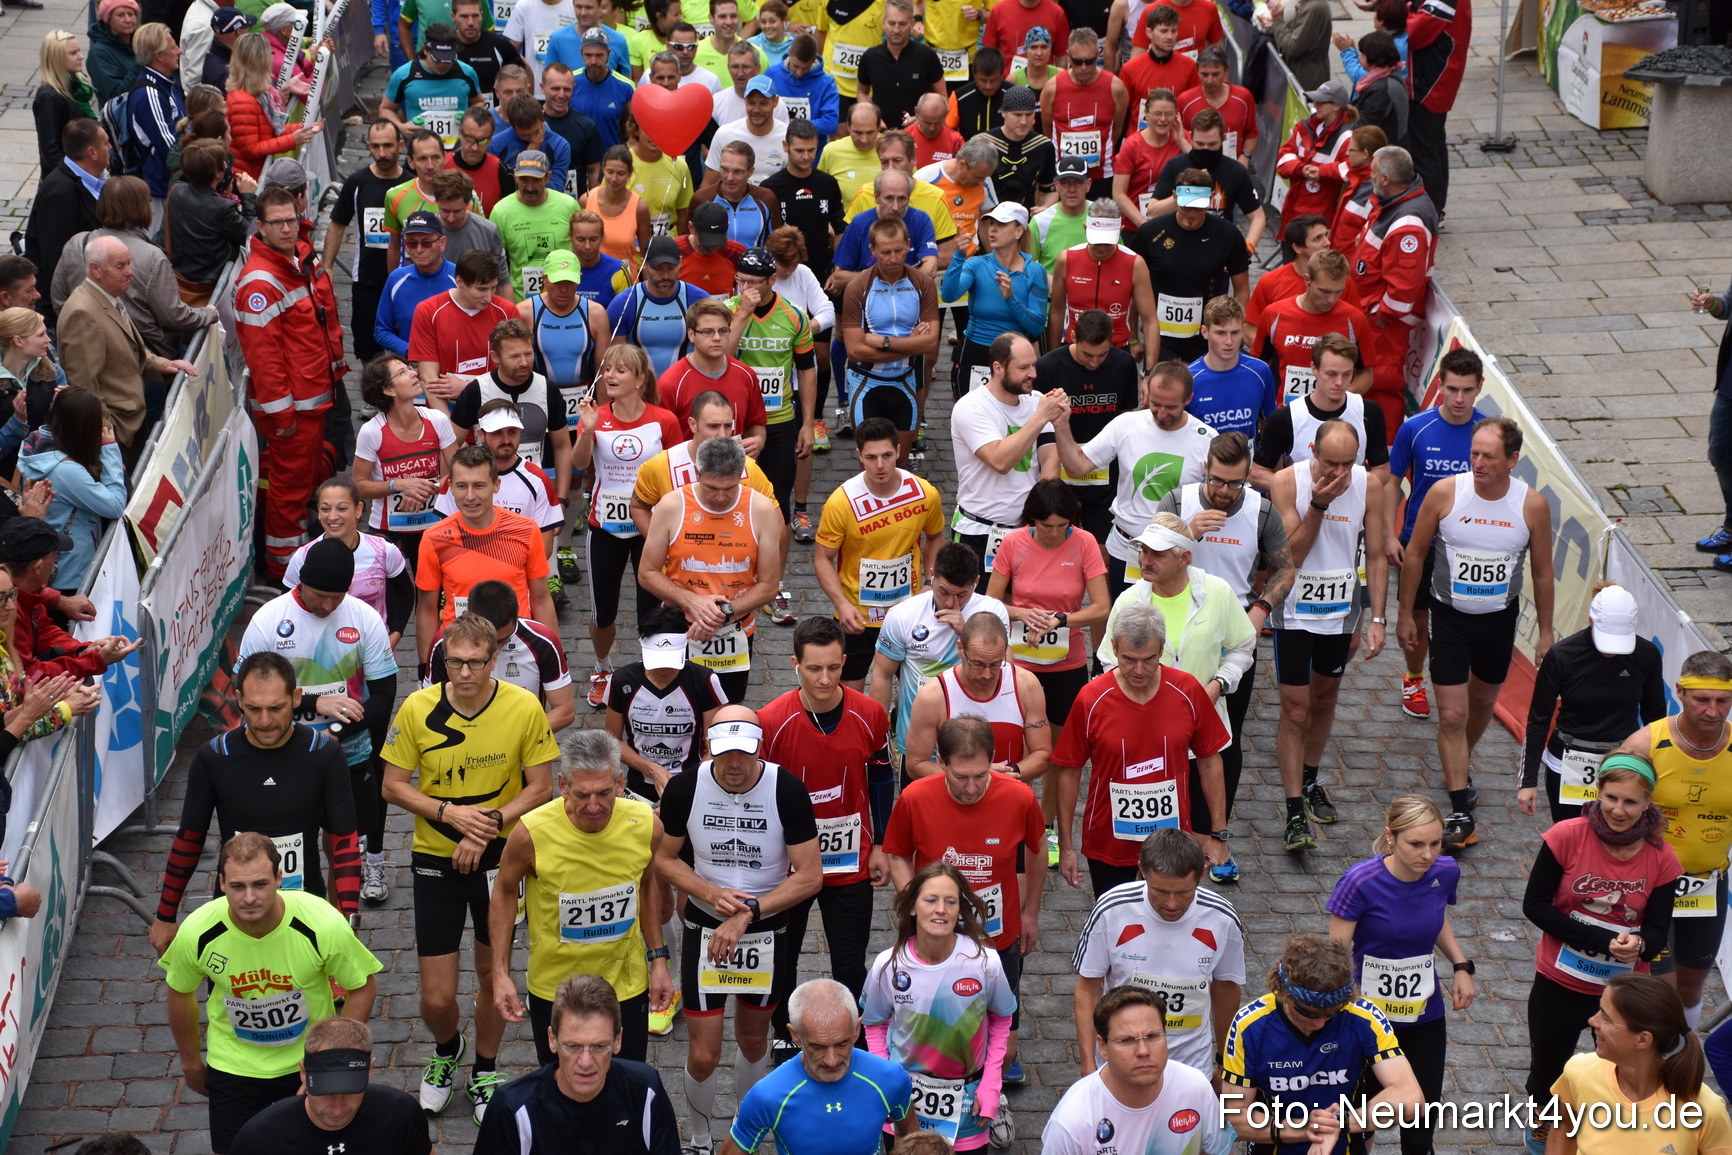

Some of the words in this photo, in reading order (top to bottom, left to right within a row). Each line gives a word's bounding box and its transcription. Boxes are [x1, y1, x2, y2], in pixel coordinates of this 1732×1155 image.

[498, 6, 512, 19] 24
[286, 36, 298, 61] BMW
[310, 68, 320, 92] BMW
[418, 96, 458, 106] HUBER
[428, 120, 451, 134] 181
[1065, 140, 1098, 154] 2199
[1165, 307, 1193, 322] 504
[738, 337, 792, 351] BOCK
[1204, 408, 1252, 424] SYSCAD
[384, 458, 427, 475] MUSCAT
[407, 515, 426, 525] Birgit
[859, 518, 891, 535] MAX
[894, 503, 929, 522] BÖGL
[1475, 518, 1514, 528] KLEBL
[1206, 536, 1242, 546] KLEBL
[1455, 552, 1473, 561] PARTL
[862, 562, 880, 570] PARTL
[881, 560, 904, 569] Neumarkt
[866, 567, 908, 588] 2713
[1458, 562, 1506, 582] 2058
[874, 591, 900, 600] Manuel
[1302, 582, 1346, 600] 2411
[1466, 586, 1494, 595] Roland
[1309, 604, 1337, 613] Thomas
[702, 636, 737, 655] 201
[703, 658, 736, 667] Thorsten
[633, 722, 691, 734] POSITIV
[641, 745, 683, 756] WOLFRUM
[466, 753, 506, 764] Triathlon
[467, 759, 507, 770] HILPOLTSTEIN
[1564, 755, 1587, 764] PARTL
[1136, 764, 1154, 774] DEHN
[1111, 788, 1133, 796] PARTL
[1118, 795, 1173, 819] 2398
[705, 816, 764, 828] POSITIV
[823, 822, 852, 830] Neumarkt
[1135, 823, 1157, 834] Ernst
[820, 830, 853, 852] 651
[710, 843, 761, 853] WOLFRUM
[589, 890, 624, 902] Neumarkt
[1674, 899, 1699, 908] chael
[568, 897, 630, 926] 2137
[583, 926, 616, 937] Rudolf
[1365, 962, 1390, 971] PARTL
[1392, 964, 1424, 972] Neumarkt
[1577, 960, 1610, 976] Sabine
[229, 968, 293, 987] Müller
[718, 974, 753, 984] Werner
[956, 983, 979, 992] Hervis
[1134, 977, 1159, 987] PARTL
[1161, 982, 1198, 991] Neumarkt
[1378, 973, 1422, 998] 362
[226, 1000, 250, 1009] PARTL
[252, 997, 290, 1009] Neumarkt
[1385, 1003, 1414, 1016] Nadja
[235, 1003, 301, 1029] 2502
[1227, 998, 1267, 1058] BOCK
[251, 1029, 294, 1041] Dominik
[1268, 1061, 1303, 1069] TEAM
[916, 1079, 951, 1090] Neumarkt
[1269, 1069, 1349, 1092] BOCK
[911, 1088, 955, 1117] 293
[1173, 1114, 1196, 1127] Hervis
